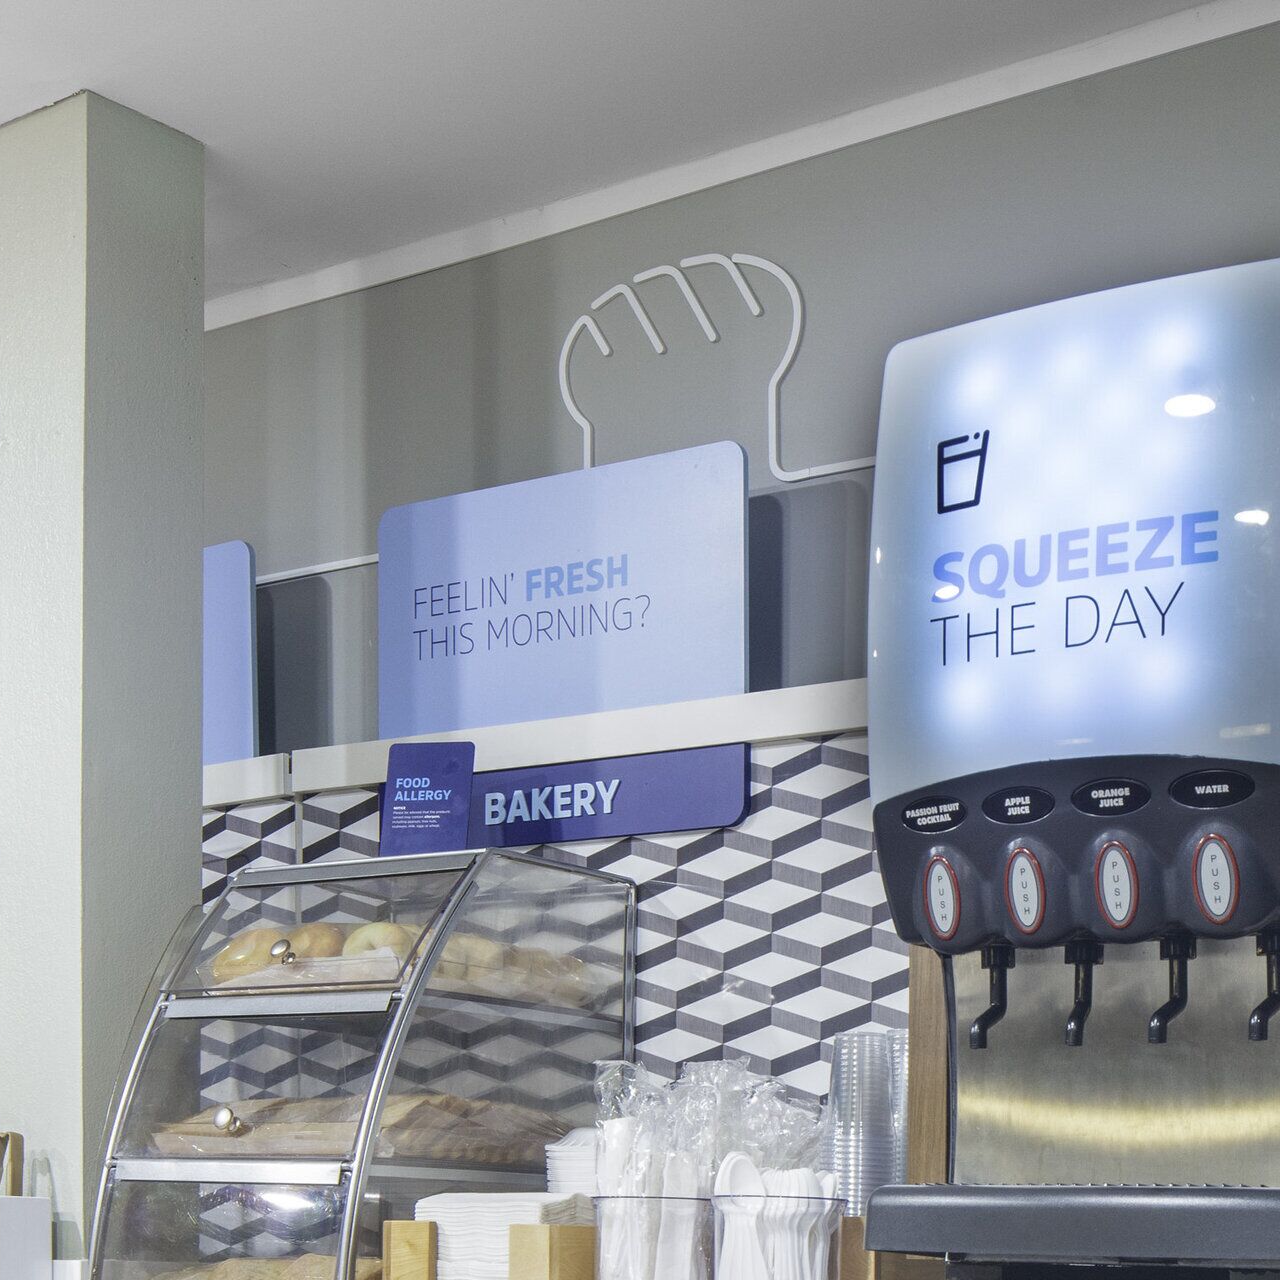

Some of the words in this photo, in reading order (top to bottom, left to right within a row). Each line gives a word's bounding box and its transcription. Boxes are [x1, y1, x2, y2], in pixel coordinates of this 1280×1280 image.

[931, 510, 1219, 603] SQUEEZE
[525, 553, 629, 602] FRESH
[413, 620, 475, 662] THIS
[487, 594, 652, 652] MORNING?
[930, 600, 1036, 666] THE
[1064, 581, 1186, 650] DAY
[394, 790, 452, 801] ALLERGY
[396, 777, 430, 788] FOOD
[1091, 787, 1131, 798] ORANGE
[1195, 784, 1230, 795] WATER
[484, 778, 621, 826] BAKERY
[906, 806, 938, 818] PASSION
[938, 802, 960, 814] FRUIT
[1005, 796, 1031, 807] APPLE
[1007, 805, 1030, 816] JUICE
[1099, 796, 1124, 808] JUICE
[917, 814, 951, 826] COCKTAIL
[1020, 868, 1030, 915] PUSH
[1111, 861, 1122, 910] PUSH
[1210, 854, 1221, 904] PUSH
[937, 876, 948, 921] PUSH
